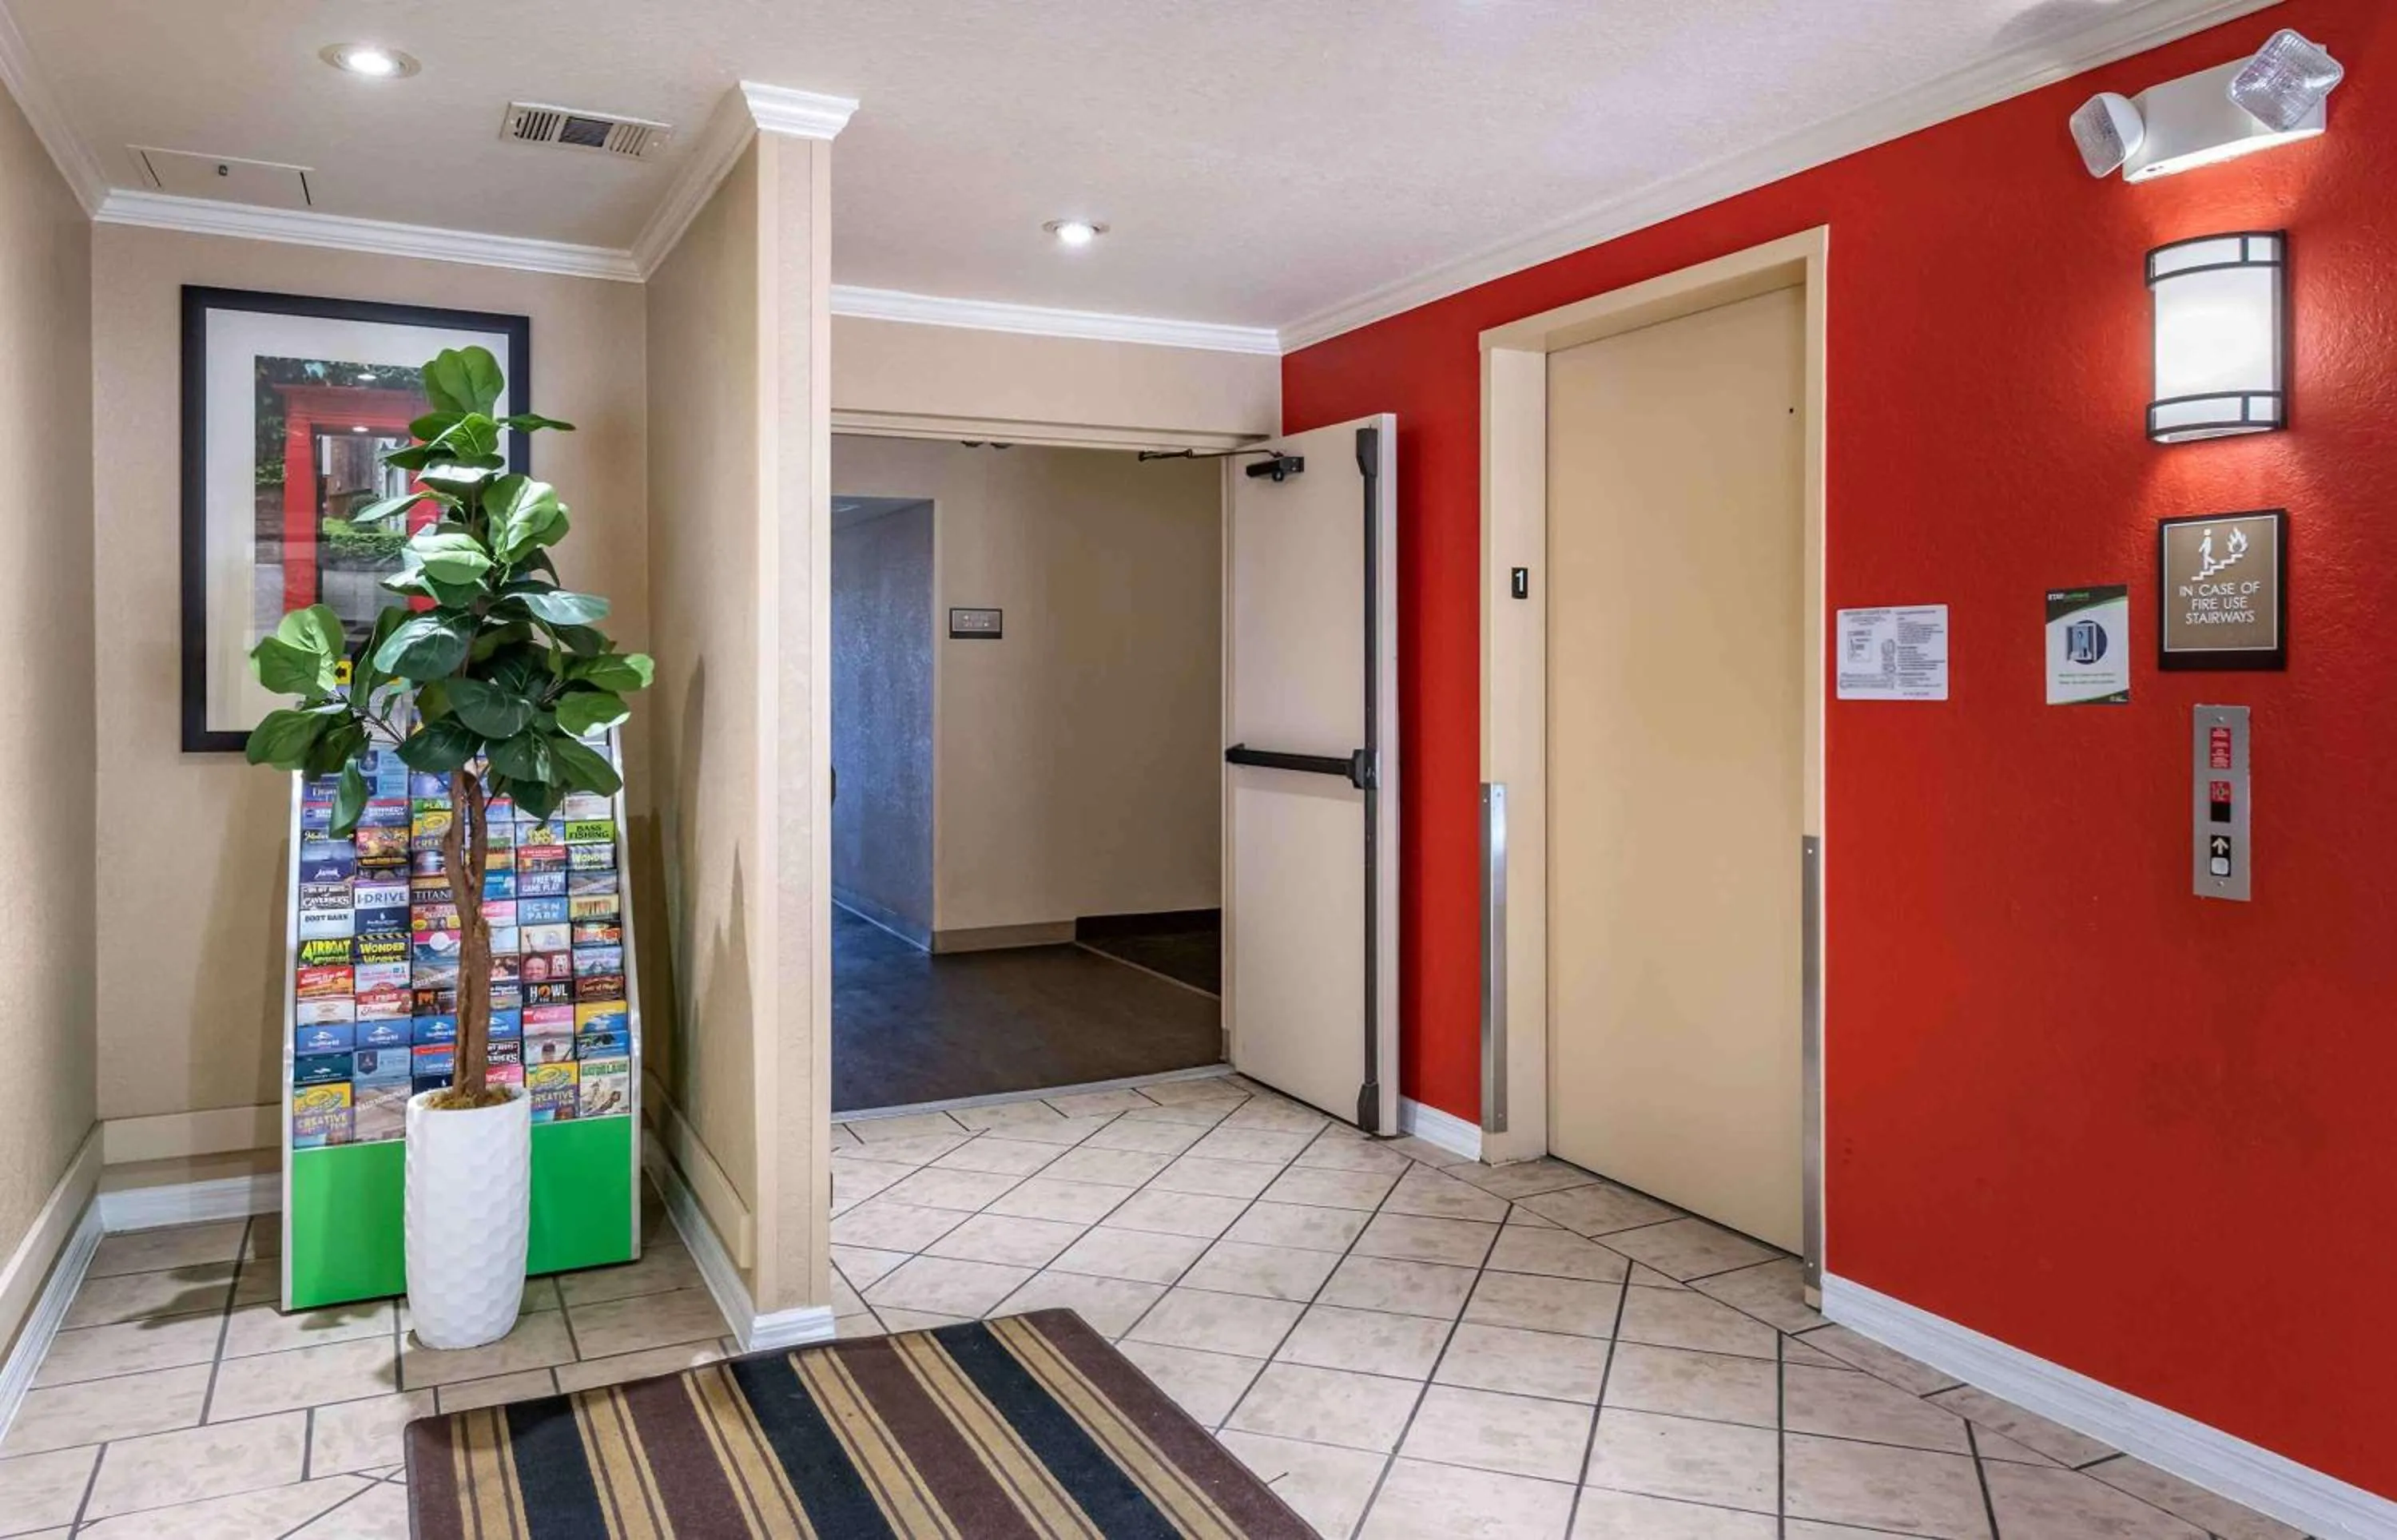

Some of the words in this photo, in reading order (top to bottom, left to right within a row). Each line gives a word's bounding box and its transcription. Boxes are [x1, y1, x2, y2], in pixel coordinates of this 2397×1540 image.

[1516, 570, 1524, 592] 1
[2179, 585, 2193, 597] IN
[2199, 582, 2236, 596] CASE
[2240, 581, 2260, 593] OF
[2192, 598, 2219, 610] FIRE
[2224, 596, 2248, 609] USE
[2185, 610, 2255, 625] STAIRWAYS
[569, 831, 609, 839] FISHING
[527, 911, 559, 920] PARK
[302, 939, 351, 959] AIRBOAT
[360, 943, 406, 954] WONDER
[531, 1091, 574, 1105] CREATIVE
[297, 1112, 347, 1127] CREATIVE
